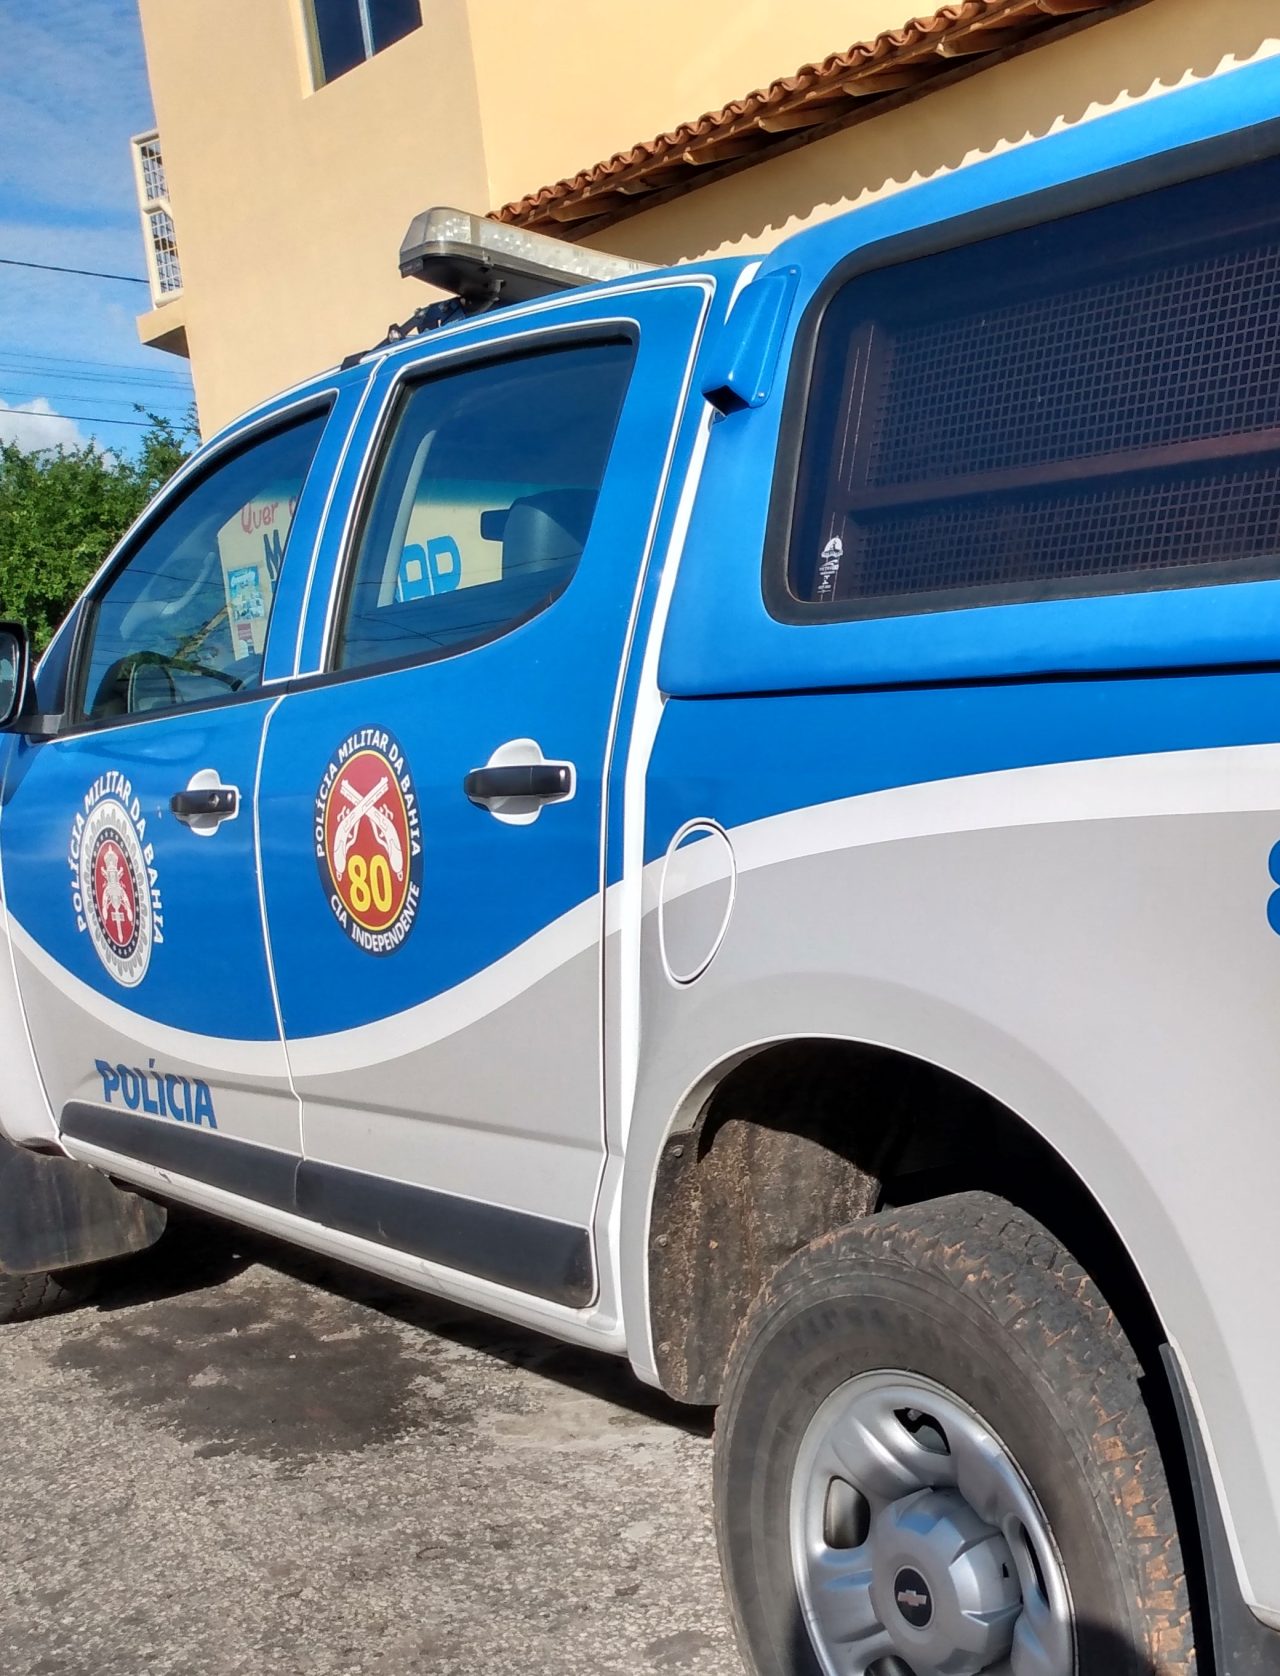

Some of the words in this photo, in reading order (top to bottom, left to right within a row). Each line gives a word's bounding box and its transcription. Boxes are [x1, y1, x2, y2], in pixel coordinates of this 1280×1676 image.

[315, 761, 339, 858] POLÍCIA
[337, 729, 390, 766] MILITAR
[388, 743, 405, 776] DA
[400, 774, 421, 857] BAHIA
[67, 812, 87, 934] POLÍCIA
[84, 770, 132, 814] MILITAR
[130, 796, 147, 841] DA
[143, 842, 165, 944] BAHIA
[347, 854, 393, 914] 80
[330, 893, 347, 930] CIA
[350, 880, 421, 952] INDEPENDENTE
[94, 1058, 218, 1129] POLÍCIA
